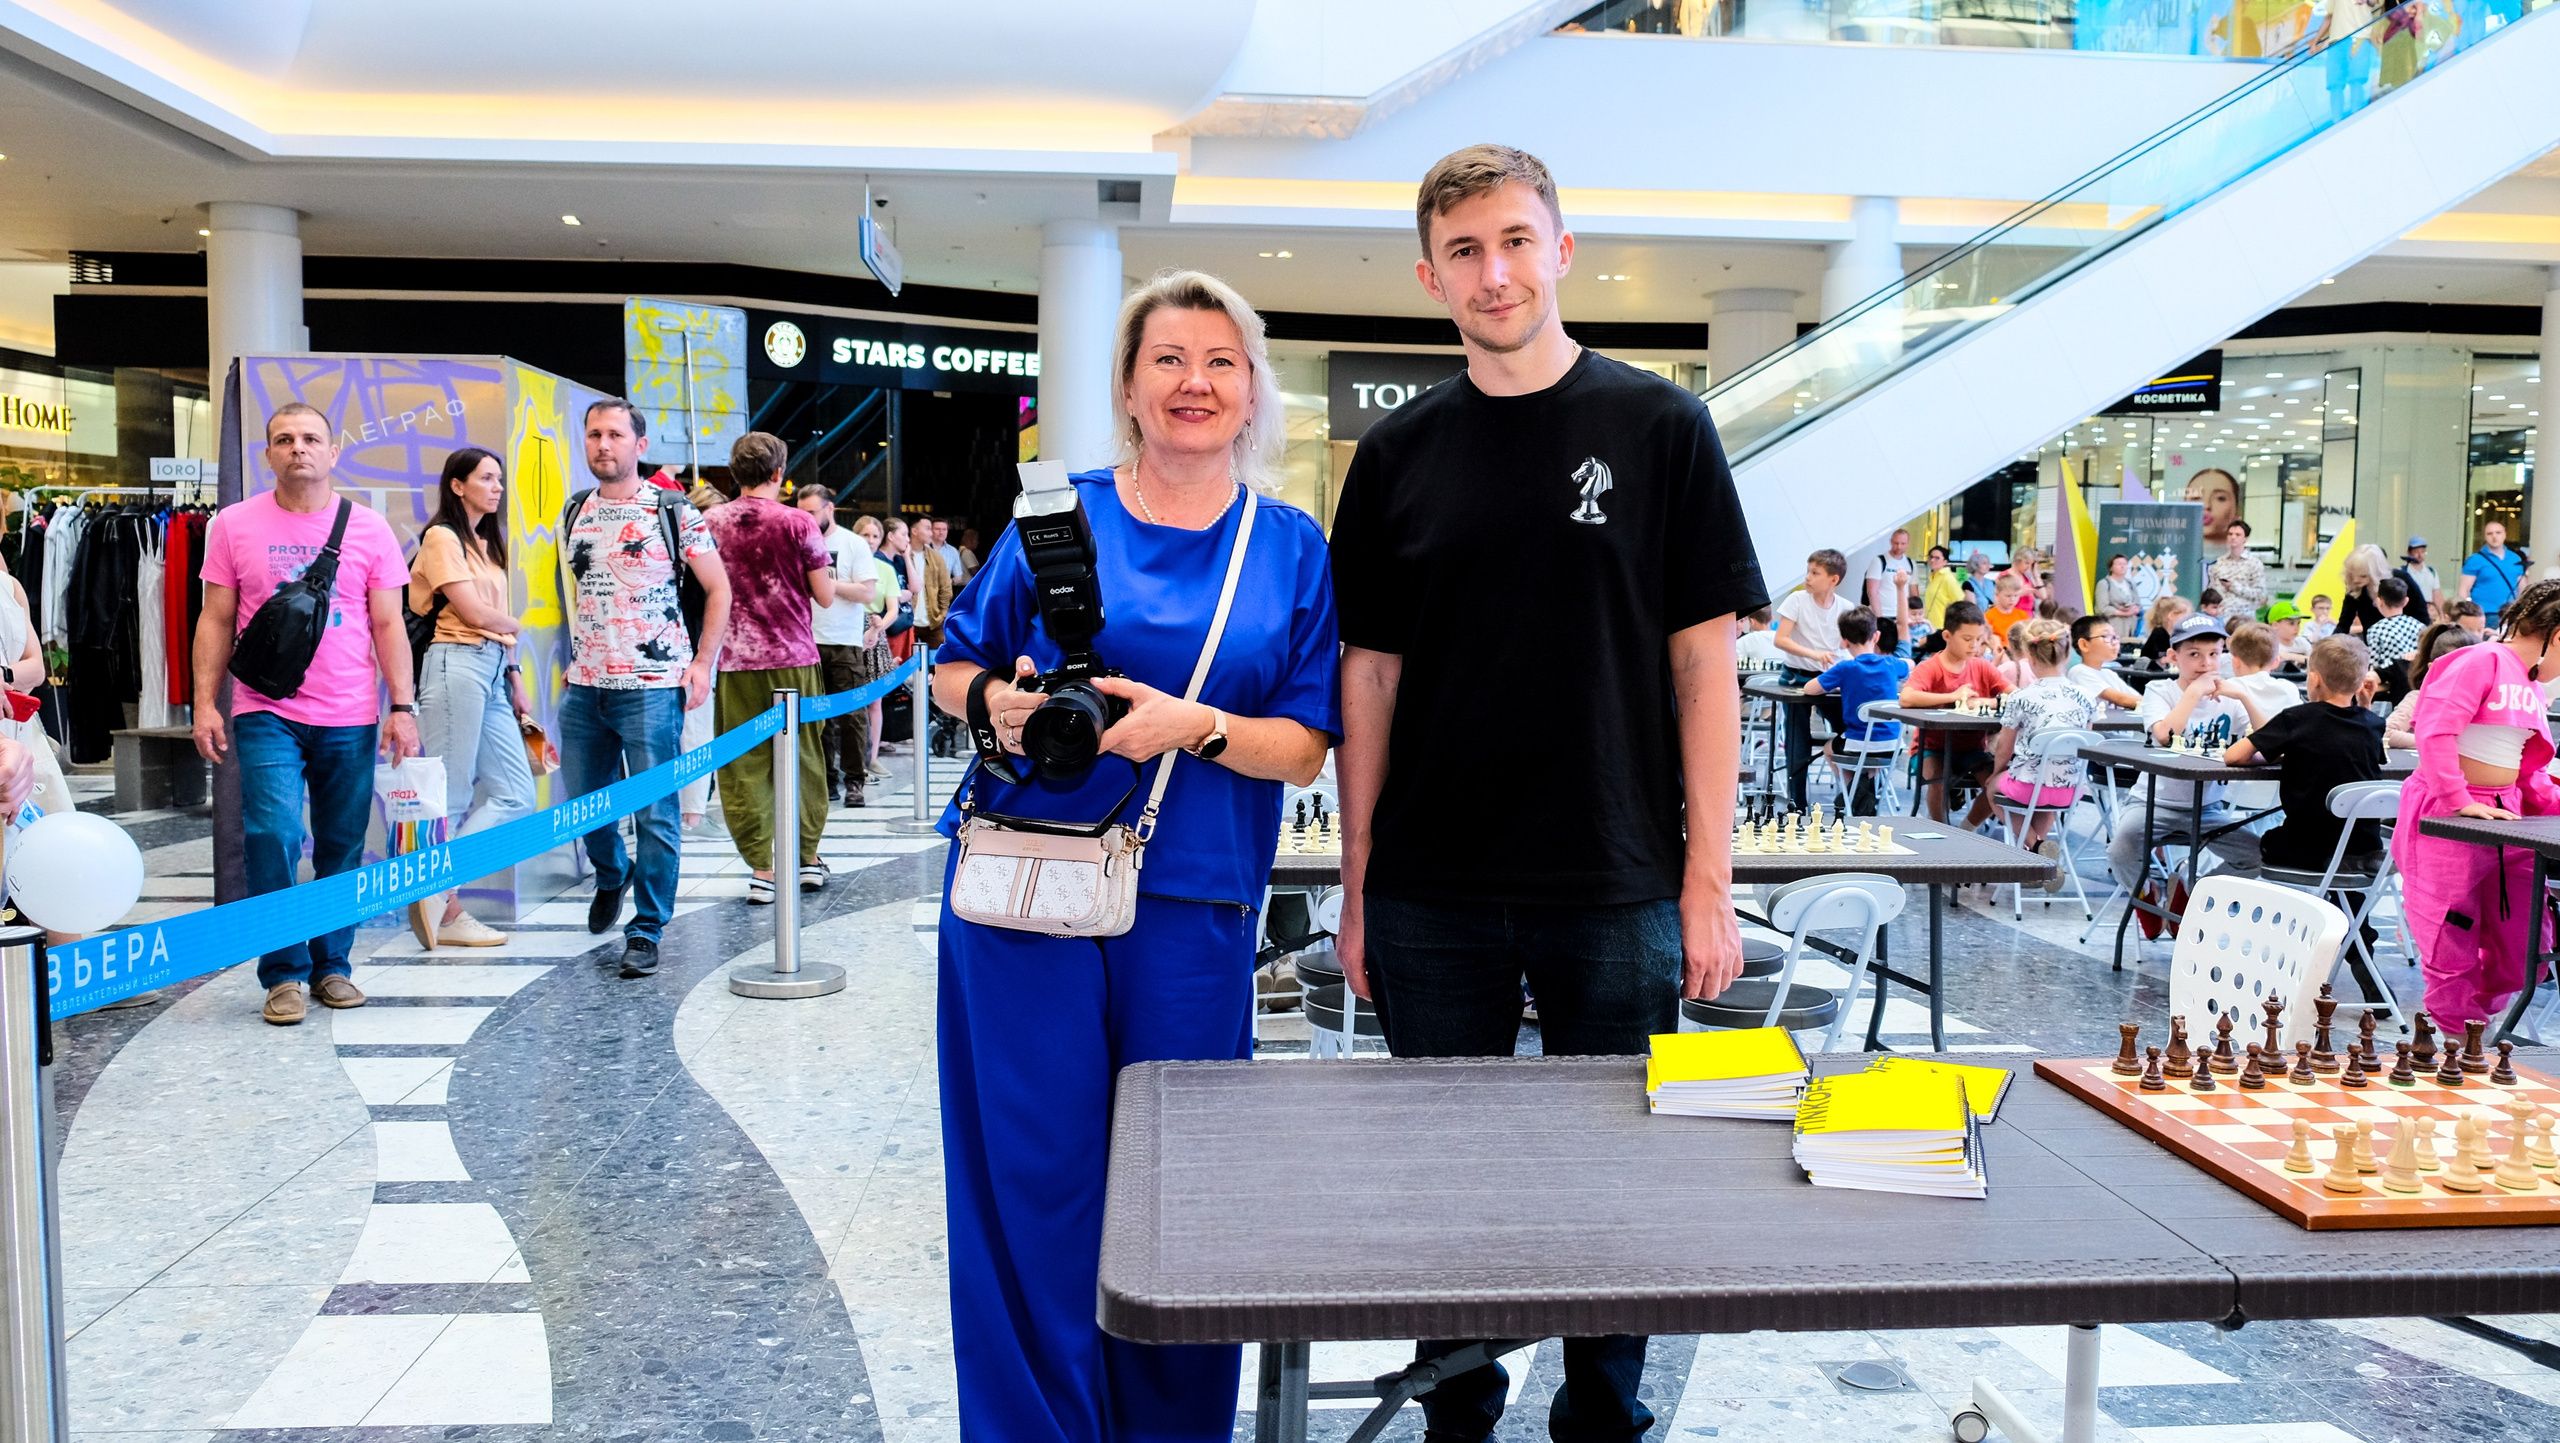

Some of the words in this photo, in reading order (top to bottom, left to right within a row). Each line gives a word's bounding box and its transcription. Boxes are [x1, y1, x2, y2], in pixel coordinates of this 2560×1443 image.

[832, 337, 926, 369] STARS
[932, 346, 1041, 377] COFFEE
[2133, 392, 2206, 405] КОСМЕТИКА
[268, 545, 325, 556] PROTE
[1049, 585, 1075, 595] Godox
[2181, 615, 2214, 630] CHESS
[1066, 662, 1088, 670] SONY
[673, 745, 713, 780] РИВЬЕРА
[553, 789, 611, 833] РИВЬЕРА
[356, 845, 453, 904] РИВЬЕРА
[143, 968, 171, 986] ЦЕНТР
[1797, 1077, 1834, 1135] TINKOFF
